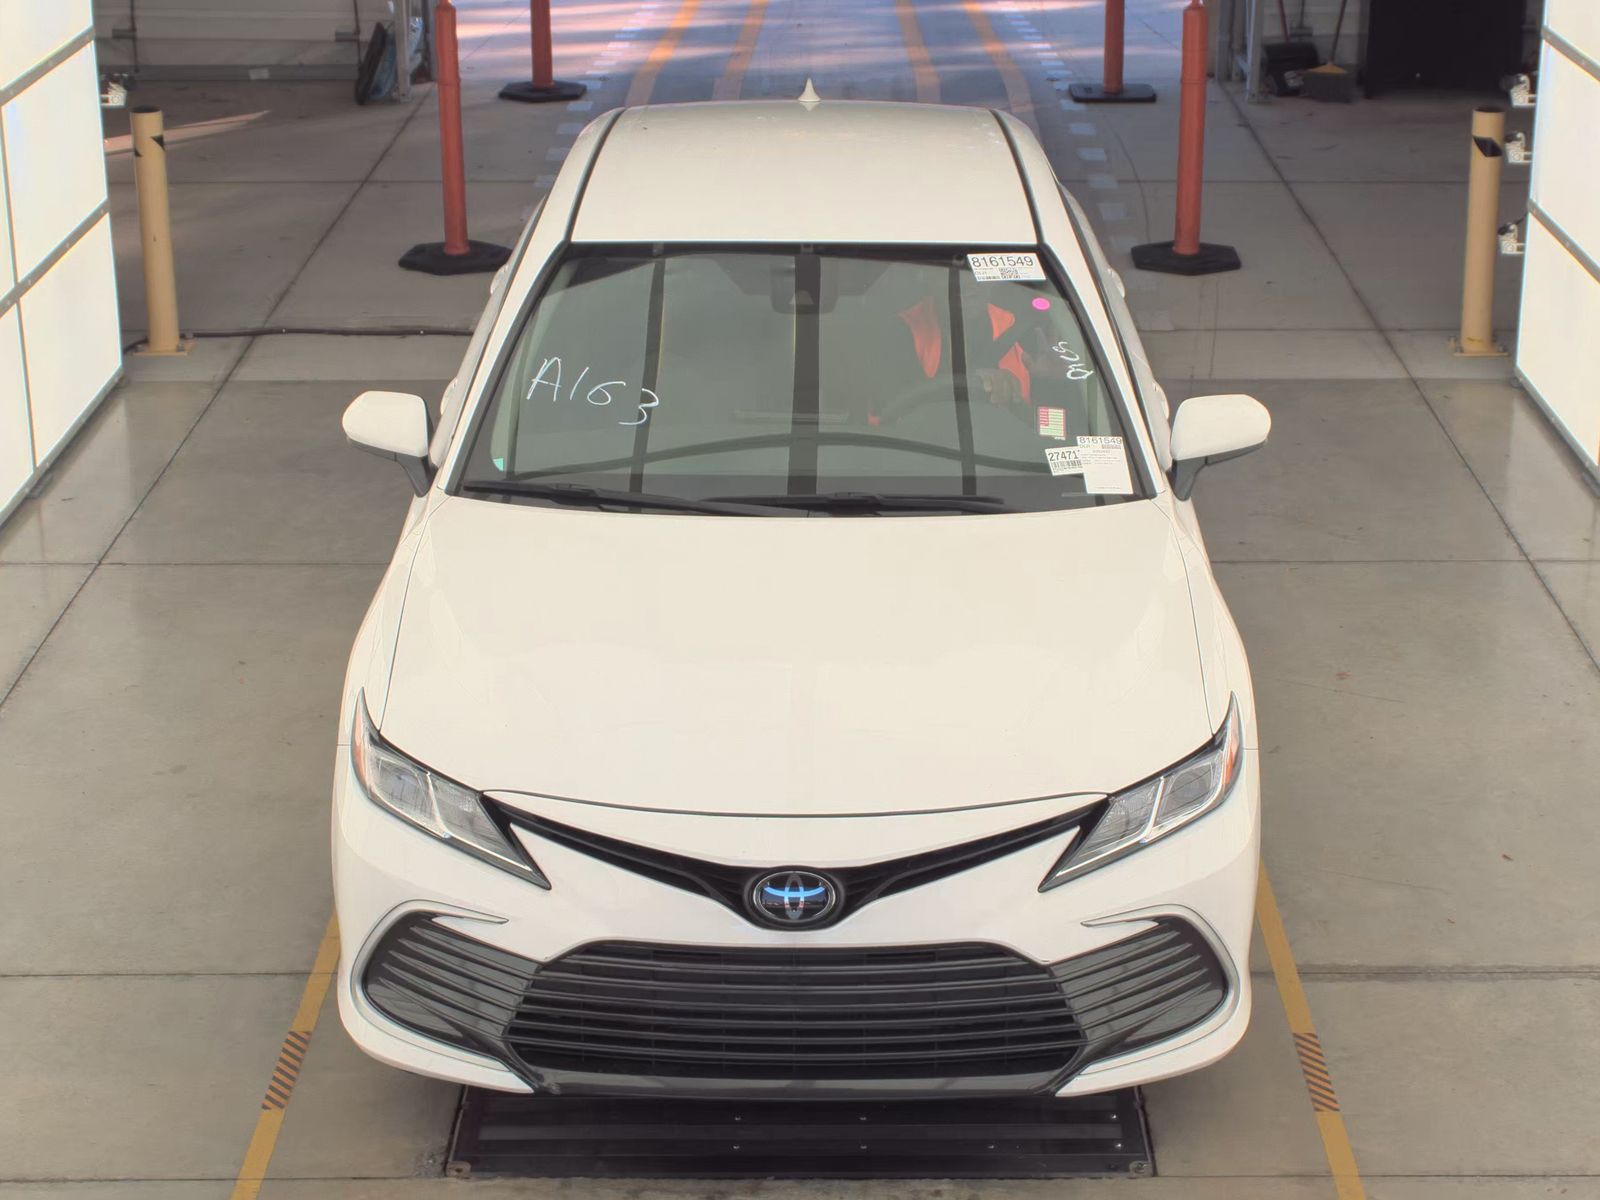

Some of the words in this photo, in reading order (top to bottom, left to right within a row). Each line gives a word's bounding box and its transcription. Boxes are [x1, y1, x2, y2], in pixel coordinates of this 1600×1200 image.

[971, 256, 1034, 268] 8161549
[1080, 436, 1122, 445] 8161549
[1048, 449, 1081, 462] 27471
